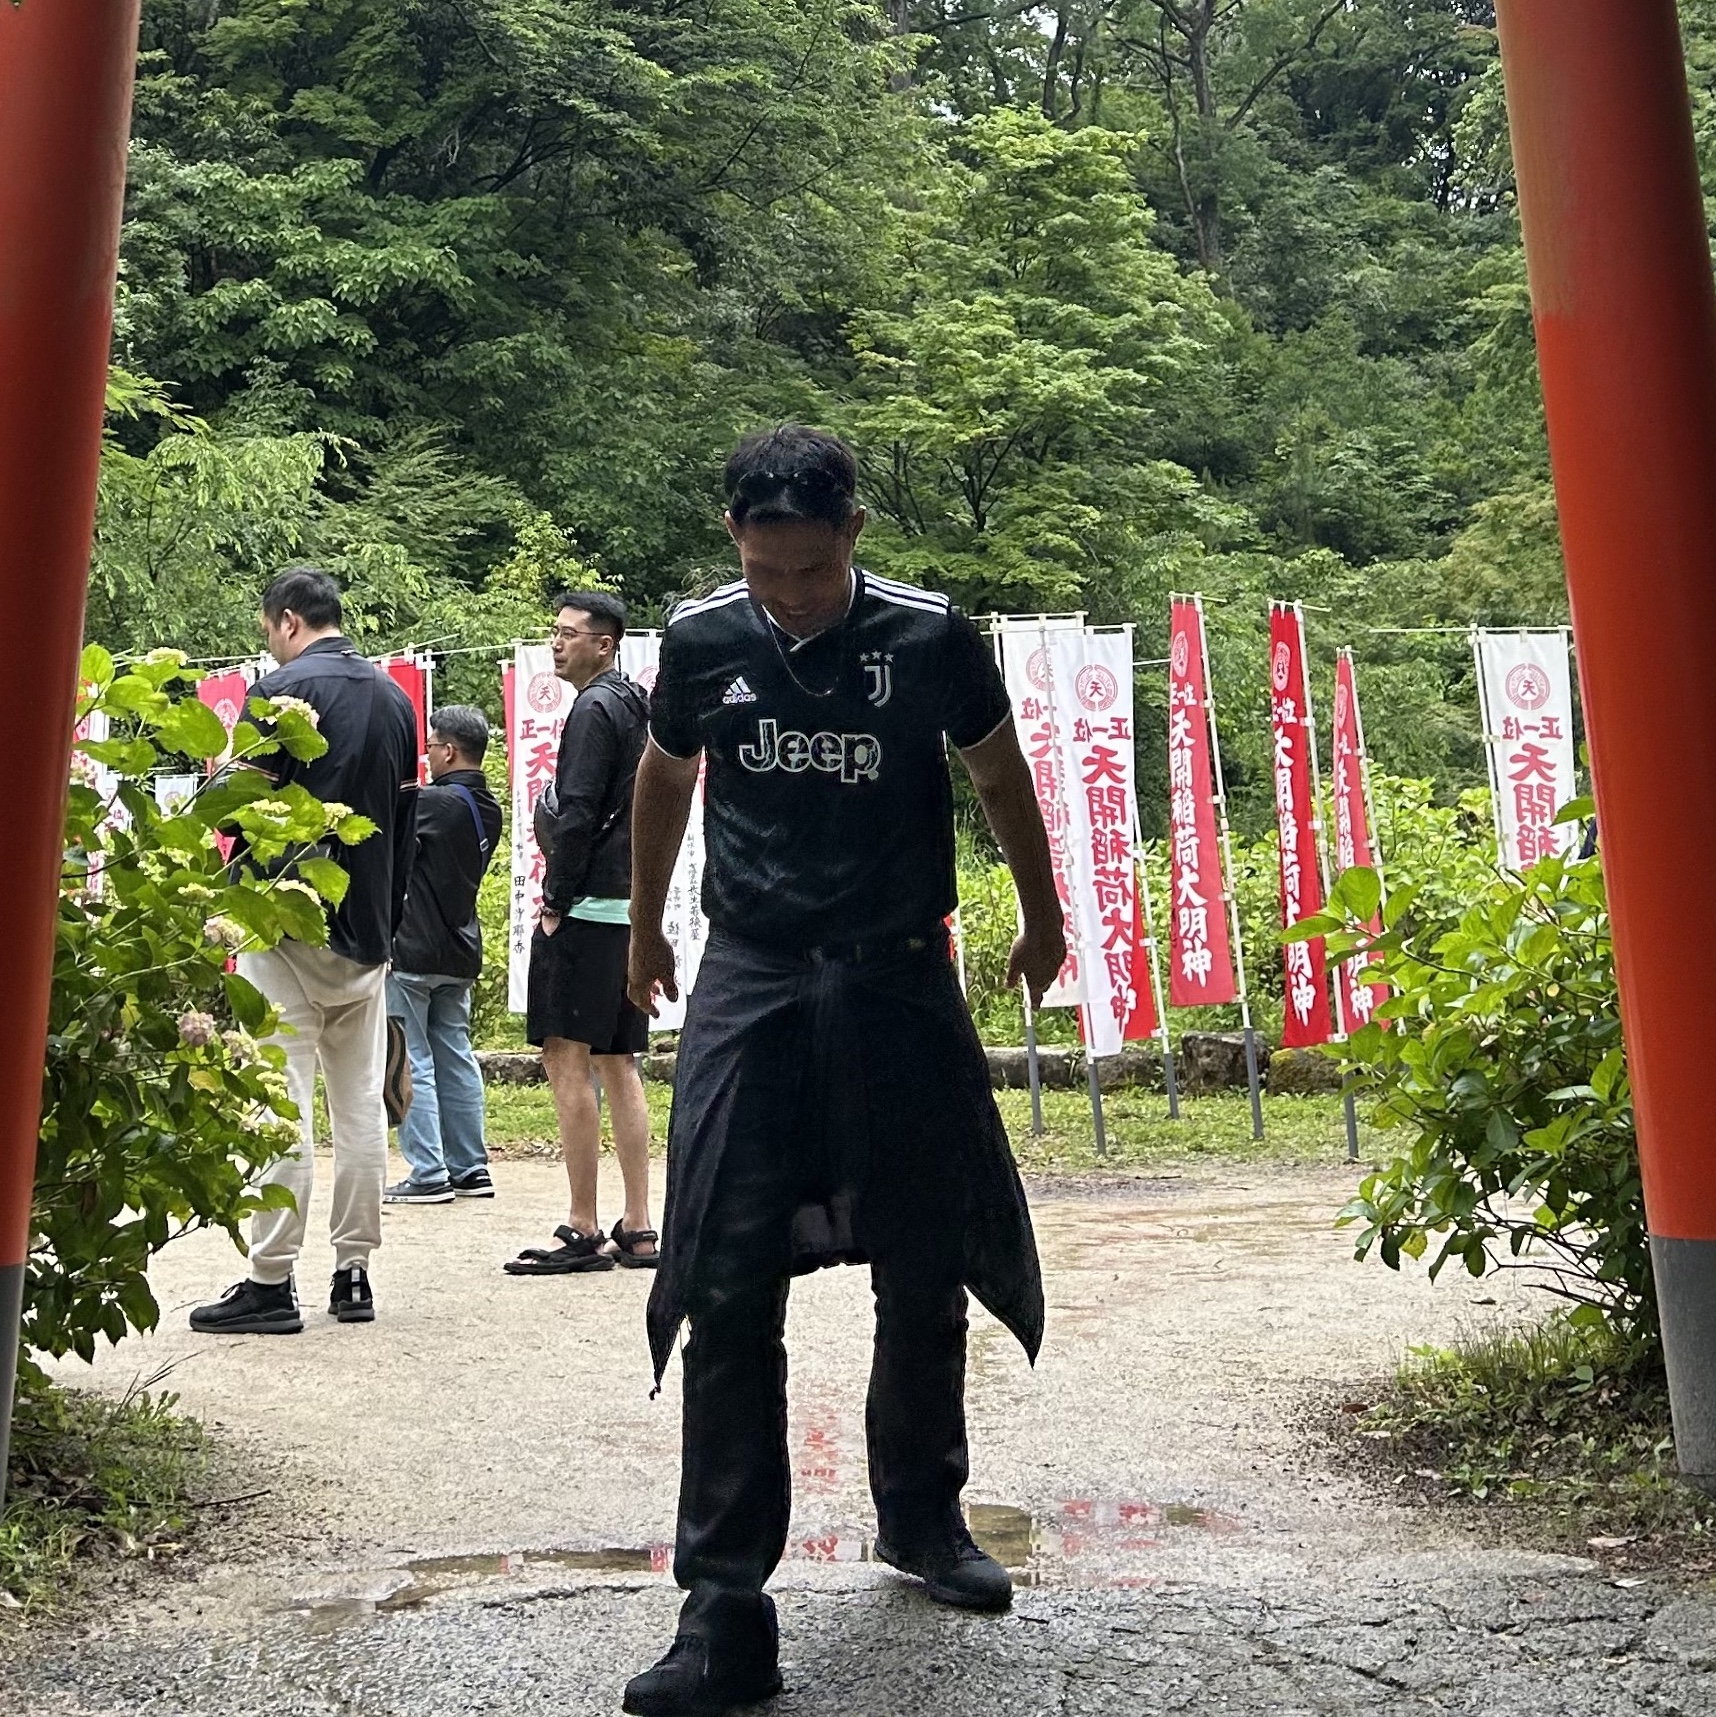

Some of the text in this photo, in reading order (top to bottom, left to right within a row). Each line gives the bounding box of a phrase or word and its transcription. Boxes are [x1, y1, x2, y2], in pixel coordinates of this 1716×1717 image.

[722, 691, 757, 705] adidas
[738, 717, 883, 785] Jeep
[1170, 707, 1212, 988] 天開稲荷大明神
